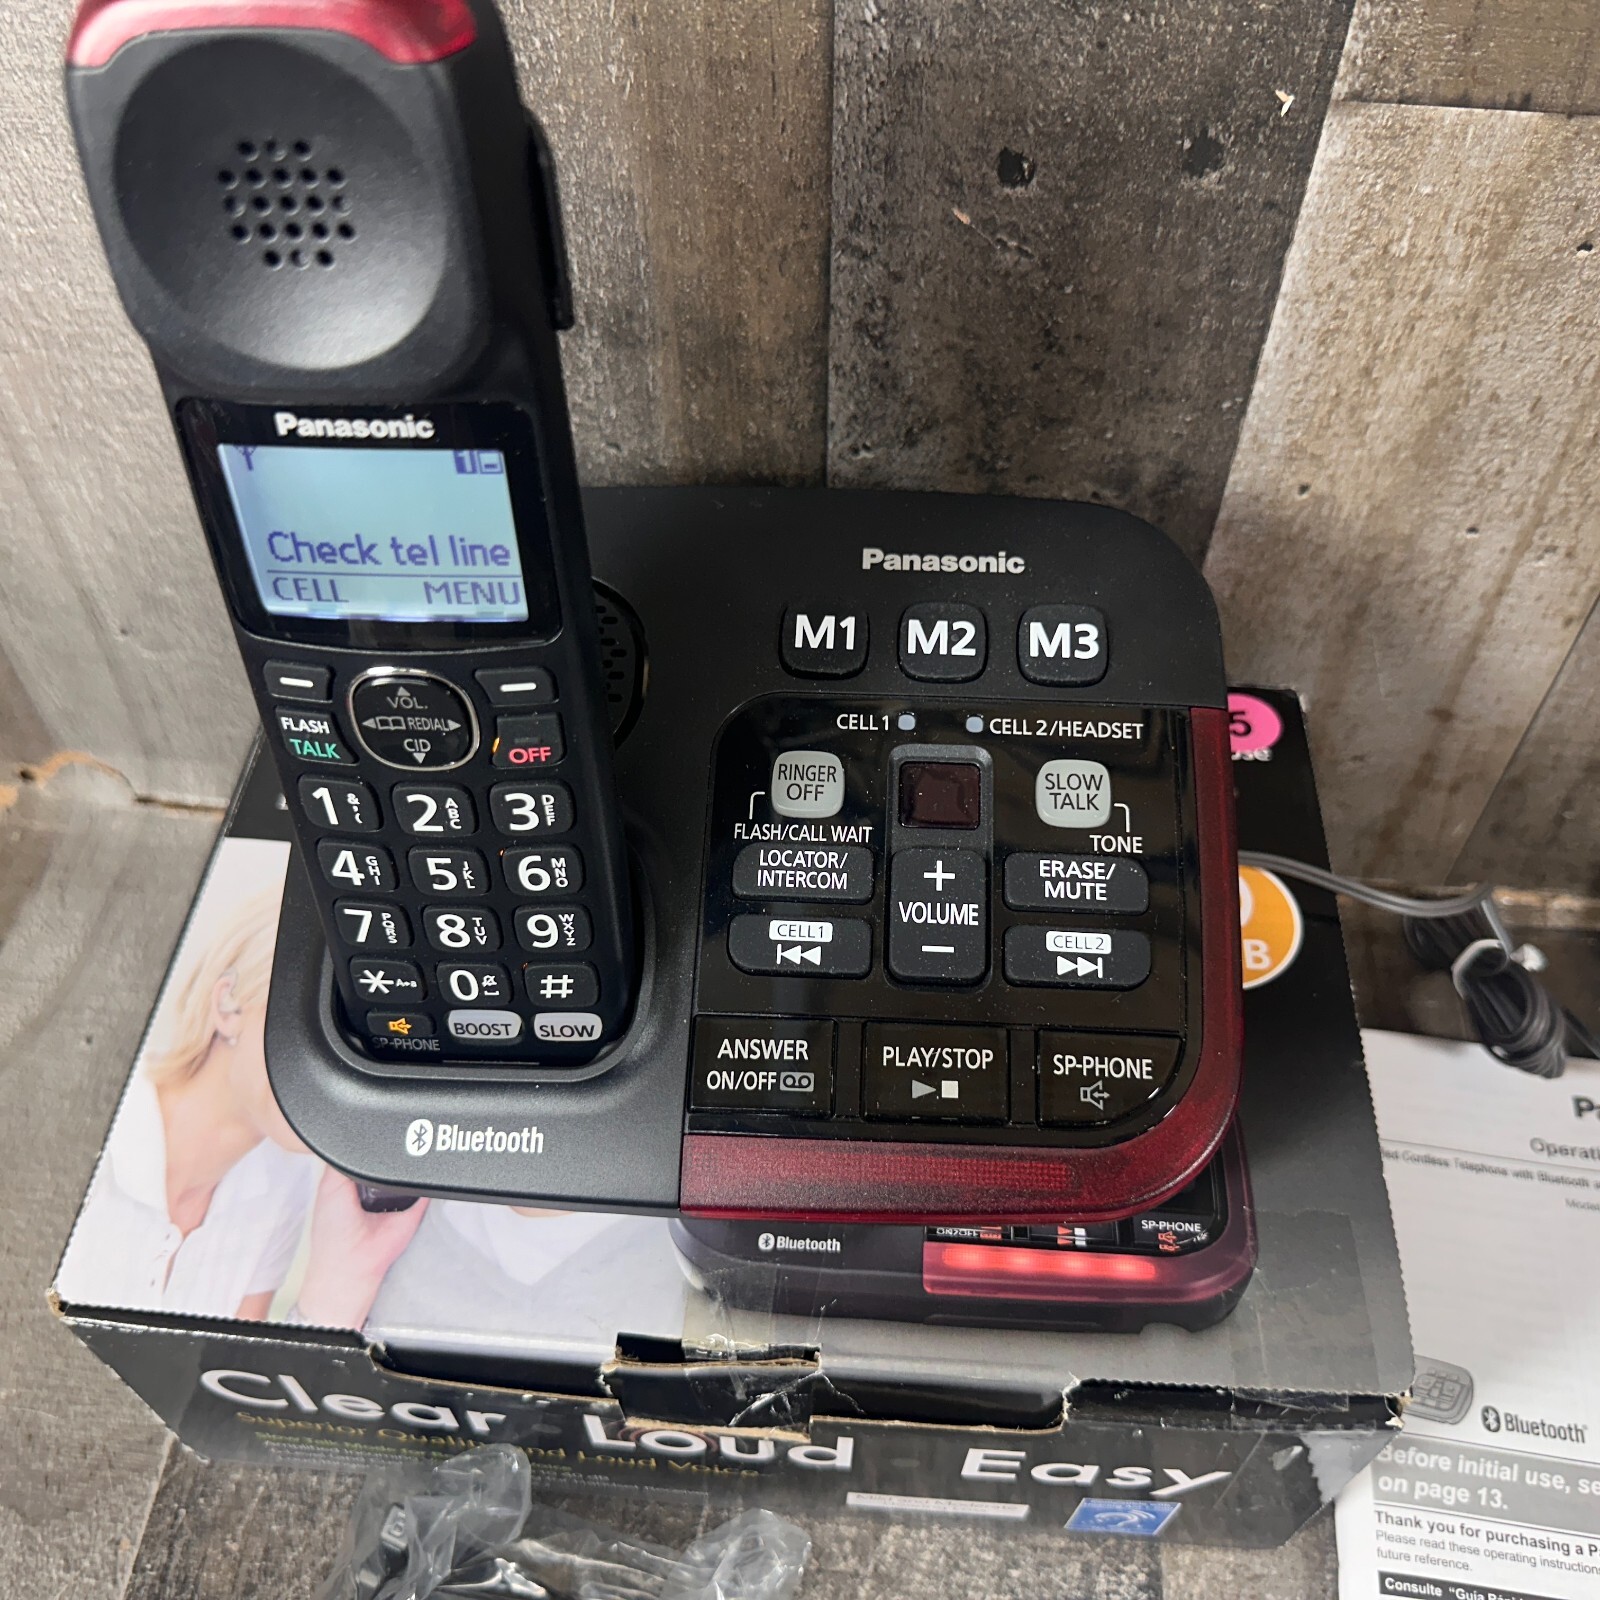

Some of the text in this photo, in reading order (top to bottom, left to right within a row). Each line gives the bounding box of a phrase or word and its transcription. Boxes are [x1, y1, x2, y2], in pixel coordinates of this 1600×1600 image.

[274, 412, 435, 439] Panasonic
[267, 531, 510, 566] Check tel line
[862, 547, 1025, 575] Panasonic
[272, 576, 521, 606] CELL MENU
[794, 614, 857, 650] M1
[907, 619, 977, 656] M2
[1029, 622, 1100, 660] M3
[386, 696, 428, 709] VOL.
[281, 717, 330, 735] FLASH
[407, 717, 449, 731] REDIAL
[989, 719, 1144, 740] CELL 2/HEADSET
[290, 738, 340, 759] TALK
[403, 738, 431, 752] CID
[508, 747, 552, 764] OFF
[777, 763, 837, 783] RINGER
[1045, 773, 1104, 792] SLOW
[786, 784, 825, 802] OFF
[1049, 792, 1100, 812] TALK
[312, 787, 339, 825] 1
[406, 793, 444, 832] 2
[504, 793, 538, 831] 3
[733, 822, 873, 844] FLASH/CALL WAIT
[1089, 834, 1143, 854] TONE
[332, 850, 365, 886] 4
[759, 849, 848, 870] LOCATOR/
[1038, 859, 1116, 882] ERASE/
[426, 857, 458, 891] 5
[518, 855, 551, 892] 6
[756, 869, 848, 891] INTERCOM
[1044, 880, 1107, 902] MUTE
[344, 909, 373, 943] 7
[899, 902, 979, 926] VOLUME
[436, 914, 471, 948] 8
[526, 914, 559, 948] 9
[450, 969, 480, 1001] 0
[453, 1022, 512, 1037] BOOST
[539, 1024, 595, 1039] SLOW
[372, 1037, 441, 1051] SP-PHONE
[717, 1039, 809, 1060] ANSWER
[882, 1046, 993, 1071] PLAY/STOP
[1052, 1054, 1153, 1079] SP-PHONE
[706, 1070, 777, 1092] ON/OFF
[436, 1124, 544, 1154] Bluetooth
[1402, 1150, 1449, 1168] Cordless
[1454, 1158, 1508, 1176] Telephone
[1512, 1168, 1533, 1180] with
[1538, 1171, 1589, 1187] Bluetooth
[1141, 1219, 1201, 1232] SP-PHONE
[776, 1235, 841, 1252] Bluetooth
[201, 1369, 1232, 1498] Clear Loud Easy
[234, 1411, 367, 1436] Superior
[577, 1451, 656, 1467] Loud
[668, 1459, 759, 1478] Voice
[1377, 1444, 1451, 1471] Before
[1458, 1454, 1519, 1482] initial
[1525, 1469, 1571, 1494] use,
[1378, 1475, 1508, 1510] on page 13.
[1375, 1510, 1600, 1557] Thank you for purchasing a P
[1375, 1530, 1416, 1545] Please
[1419, 1536, 1446, 1550] read
[1448, 1540, 1480, 1556] these
[1483, 1548, 1537, 1567] operating
[1377, 1547, 1473, 1571] future reference.
[1384, 1577, 1443, 1597] Consulte
